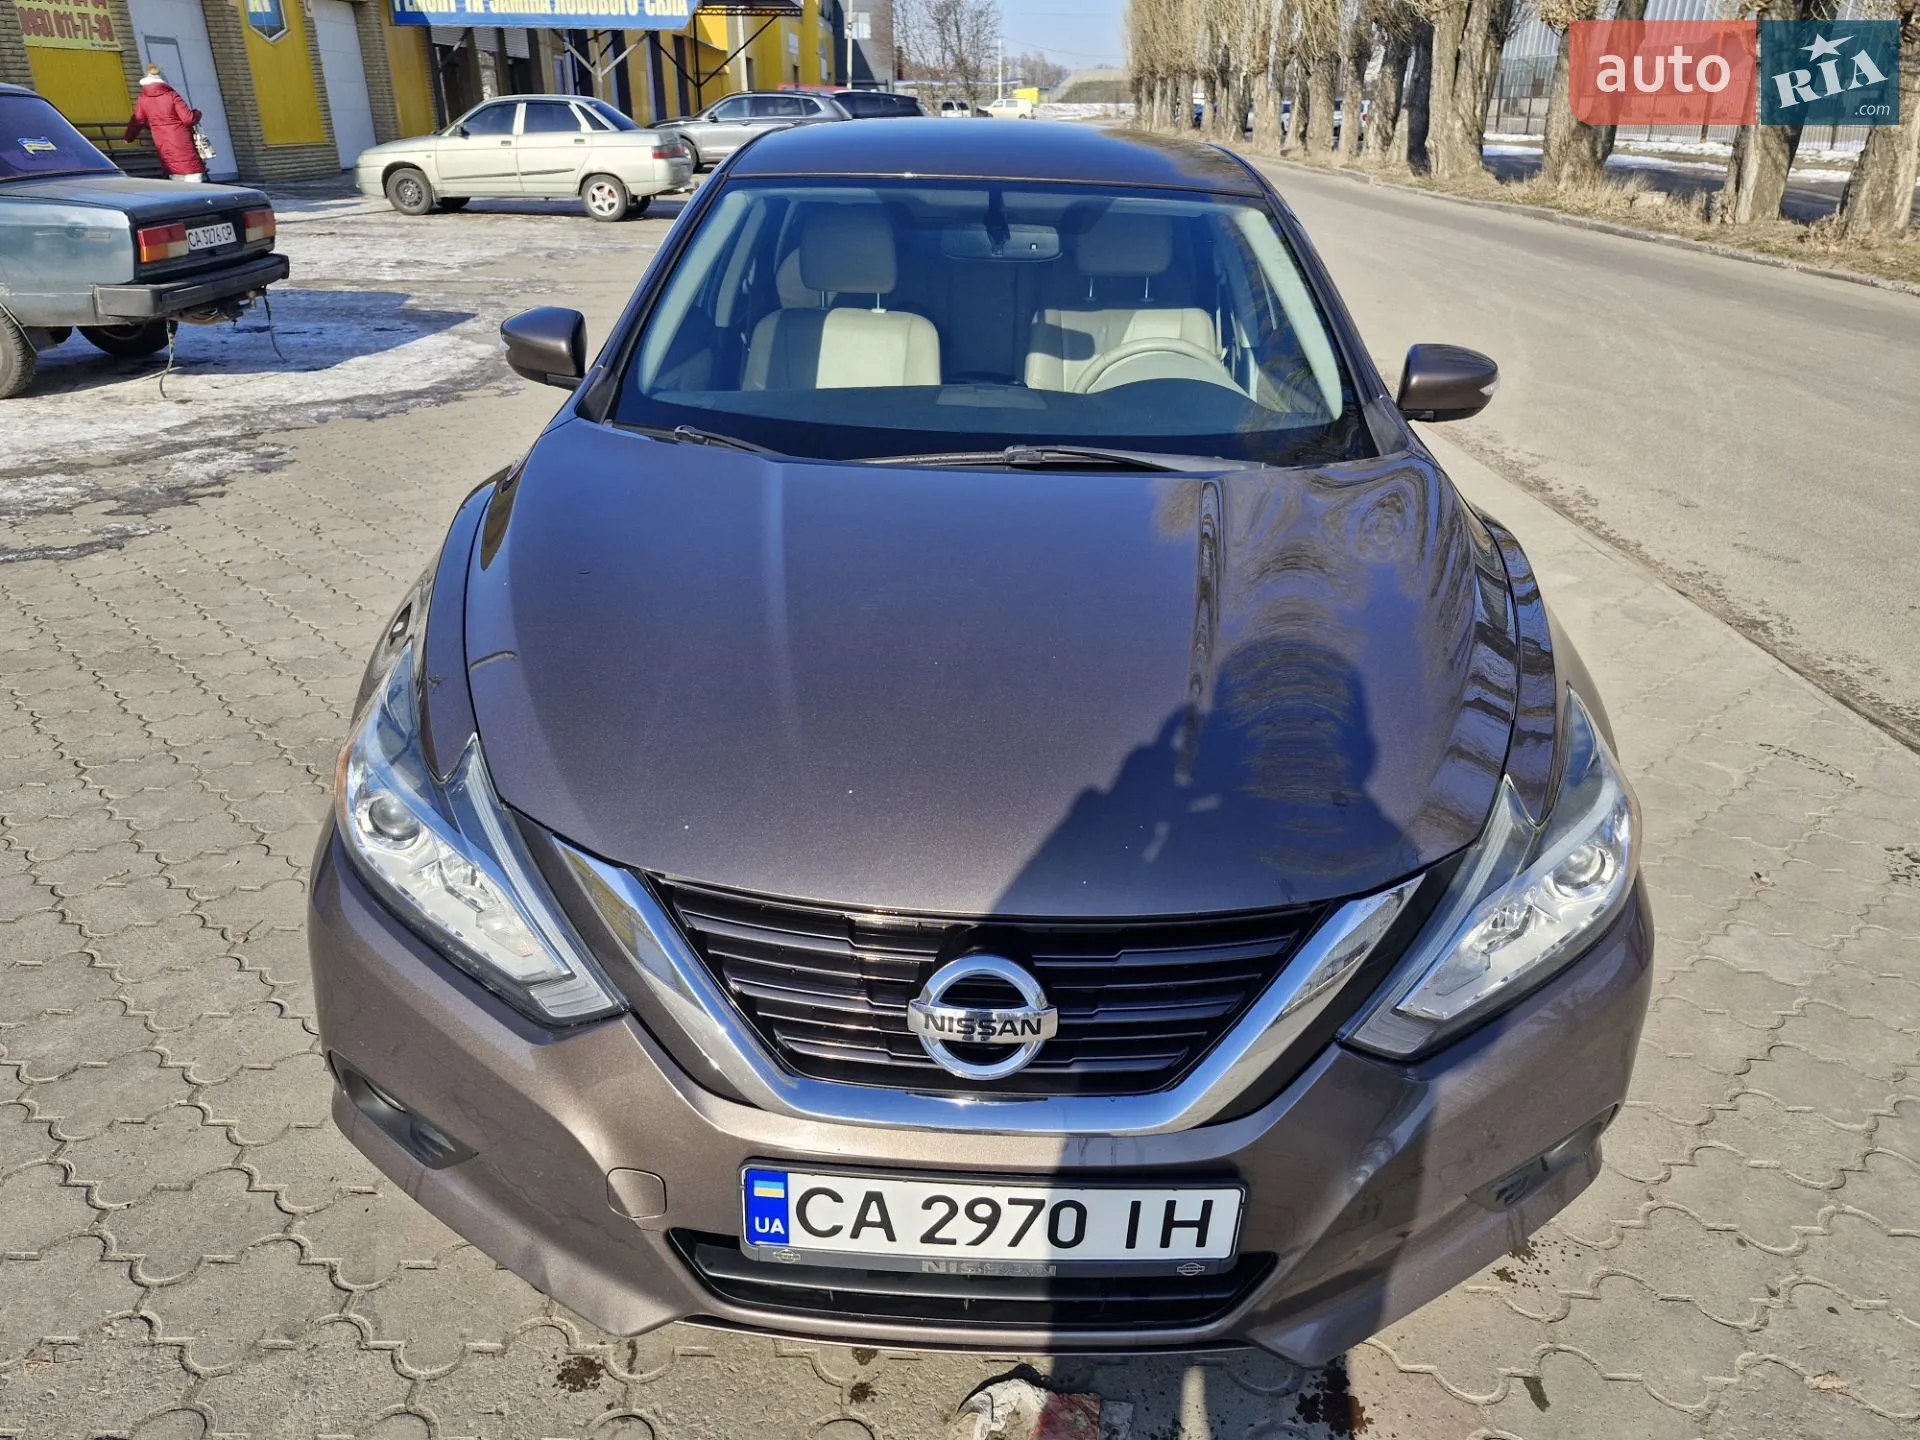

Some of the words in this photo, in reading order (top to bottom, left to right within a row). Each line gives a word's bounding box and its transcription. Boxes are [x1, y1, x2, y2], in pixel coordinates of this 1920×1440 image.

[924, 1014, 1042, 1036] NISSAN
[755, 1217, 785, 1236] UA
[796, 1187, 897, 1243] CA
[920, 1197, 1088, 1249] 2970
[1125, 1200, 1214, 1249] IH
